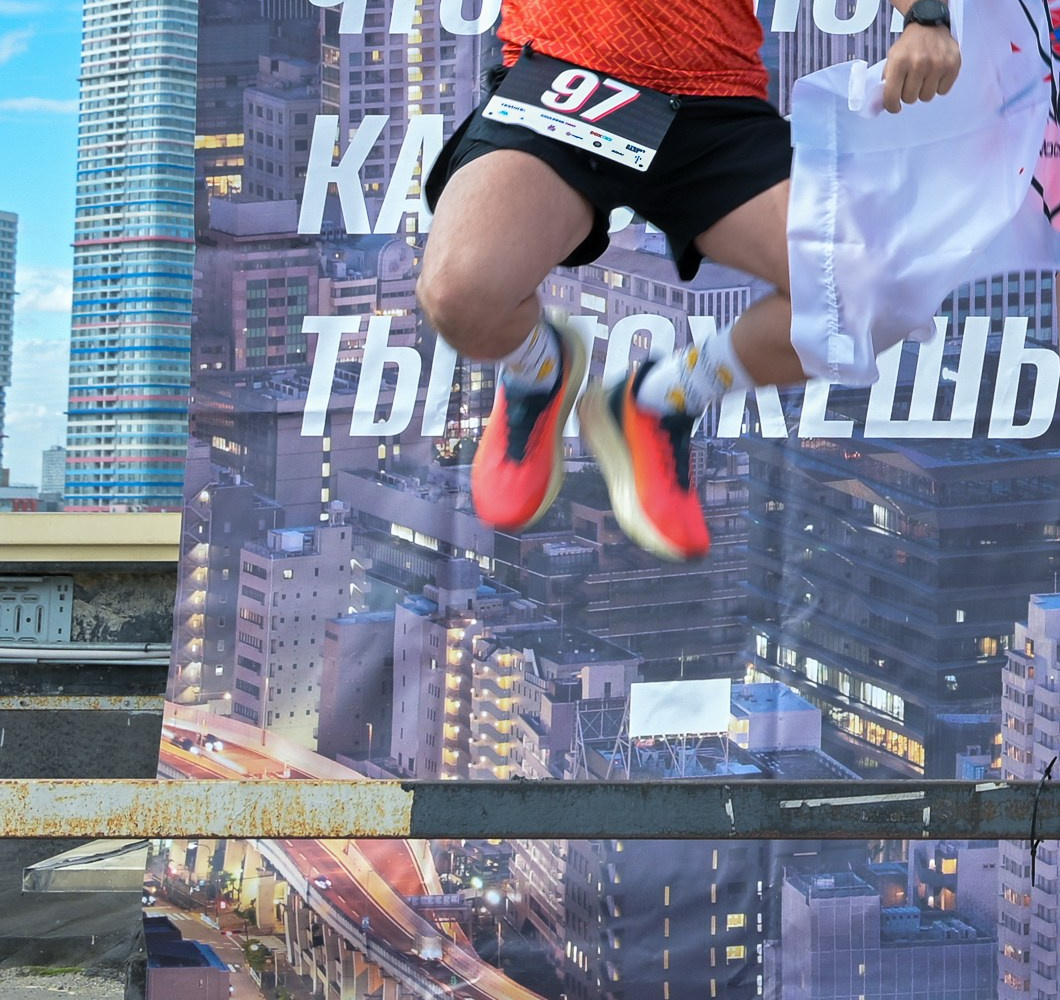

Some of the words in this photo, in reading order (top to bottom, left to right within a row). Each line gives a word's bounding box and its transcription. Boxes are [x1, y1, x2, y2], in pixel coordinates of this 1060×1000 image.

[540, 68, 641, 123] 97
[296, 113, 444, 235] КА
[300, 315, 458, 438] ТЫ
